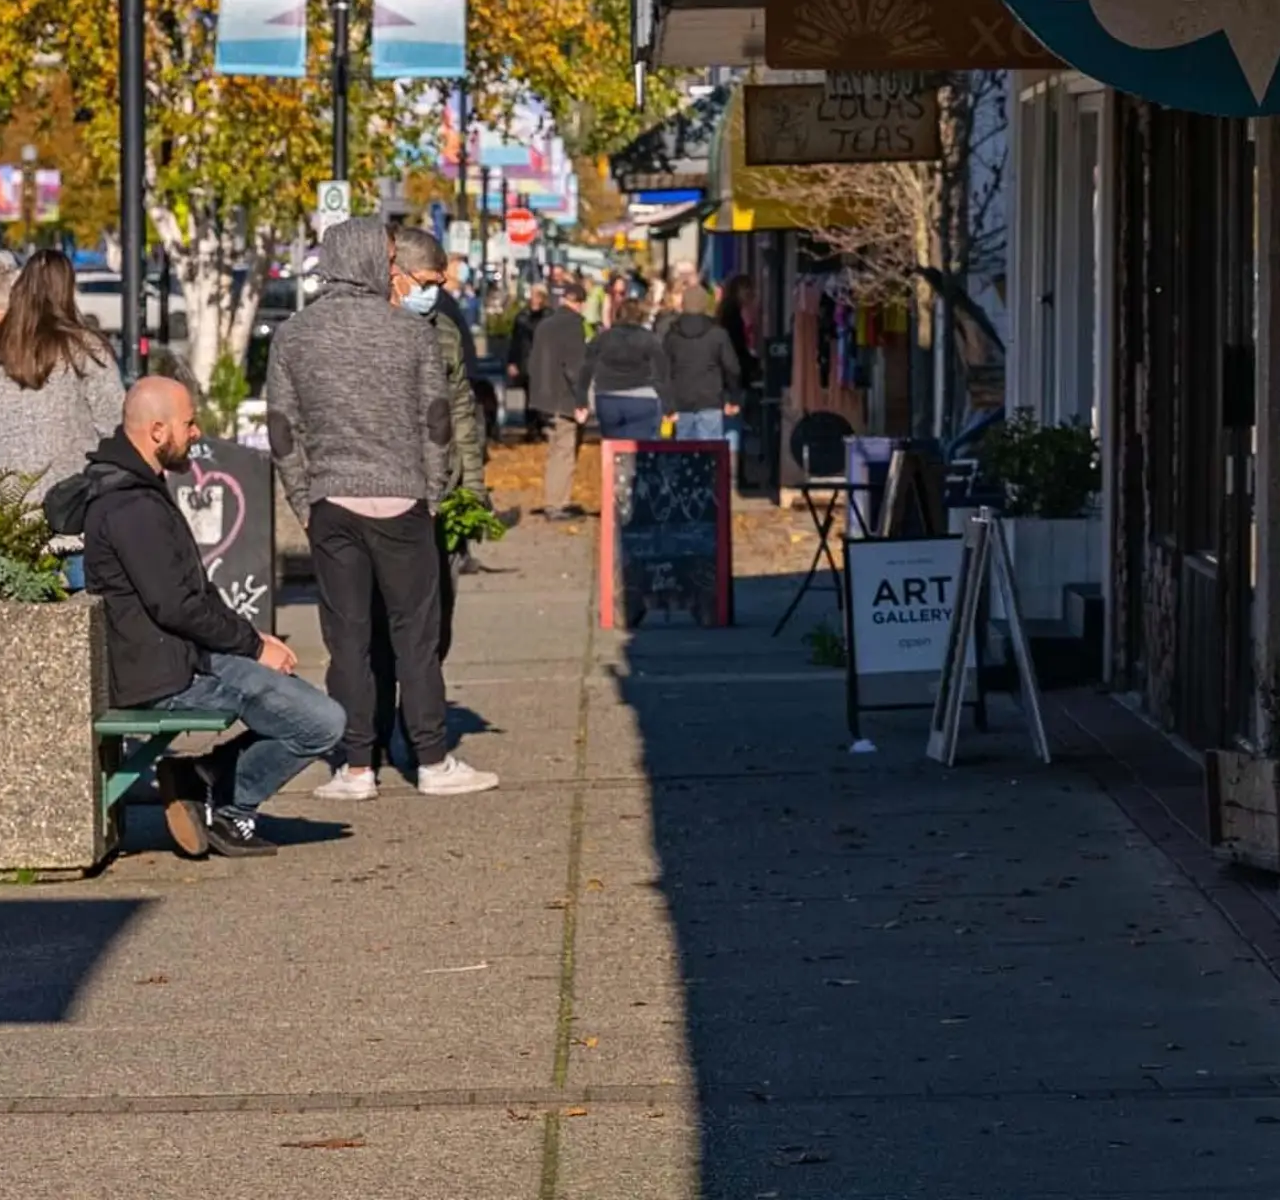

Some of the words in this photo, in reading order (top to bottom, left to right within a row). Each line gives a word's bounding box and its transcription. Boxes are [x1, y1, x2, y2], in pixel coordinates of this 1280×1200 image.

[829, 121, 915, 154] TEAS
[872, 575, 953, 607] ART
[872, 608, 952, 624] GALLERY
